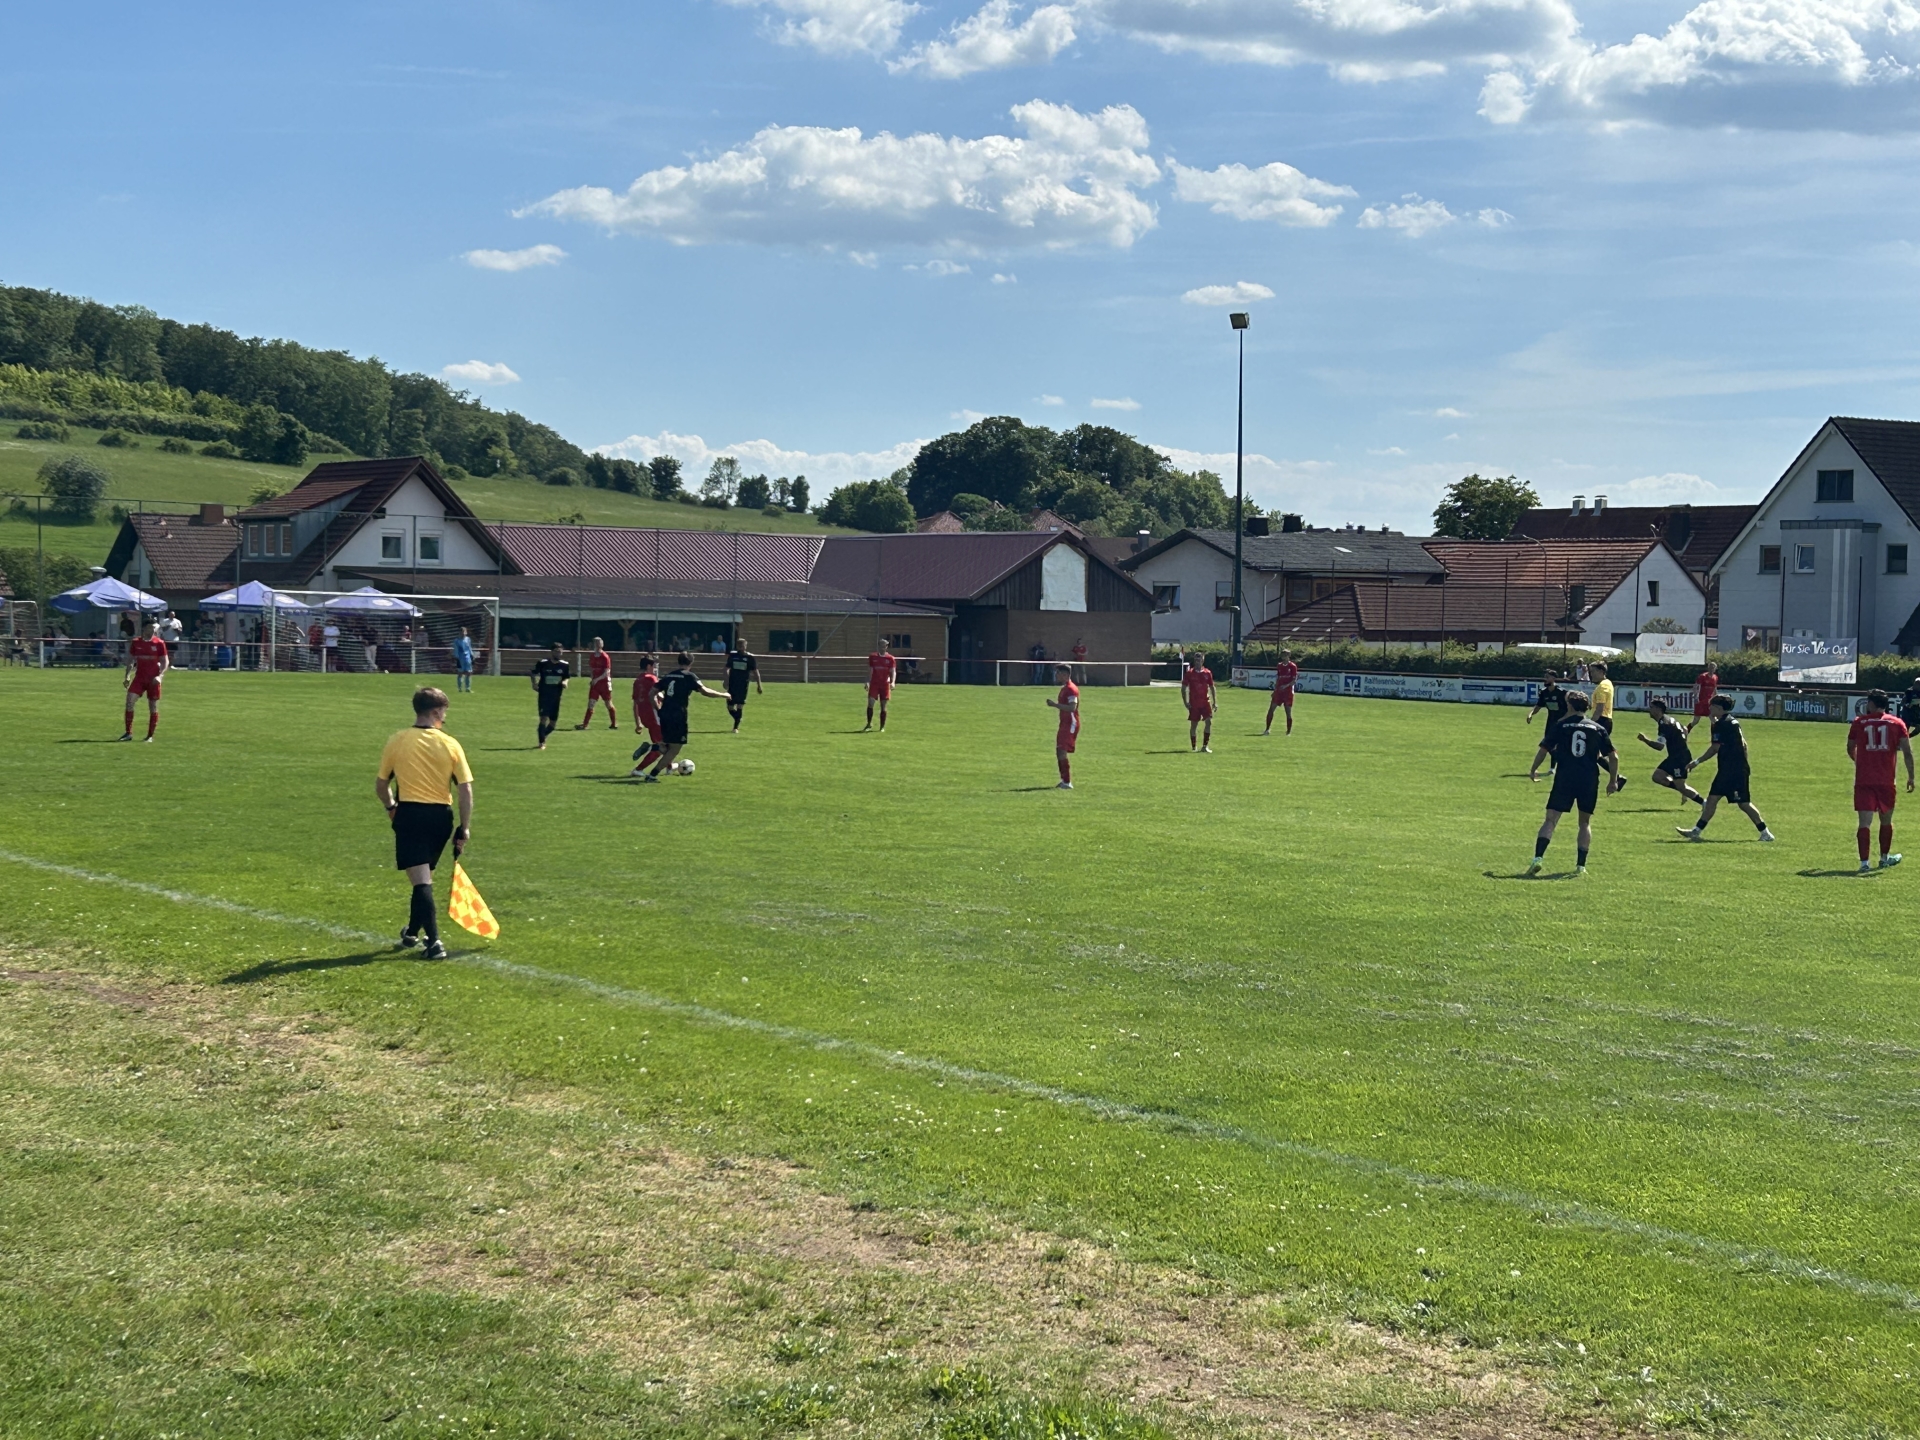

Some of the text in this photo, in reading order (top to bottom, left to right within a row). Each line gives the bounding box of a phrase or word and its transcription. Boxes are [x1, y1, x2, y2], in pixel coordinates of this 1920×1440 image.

[1782, 641, 1848, 654] Für Sie Vor Ort
[1571, 730, 1587, 758] 6
[1864, 724, 1889, 751] 11
